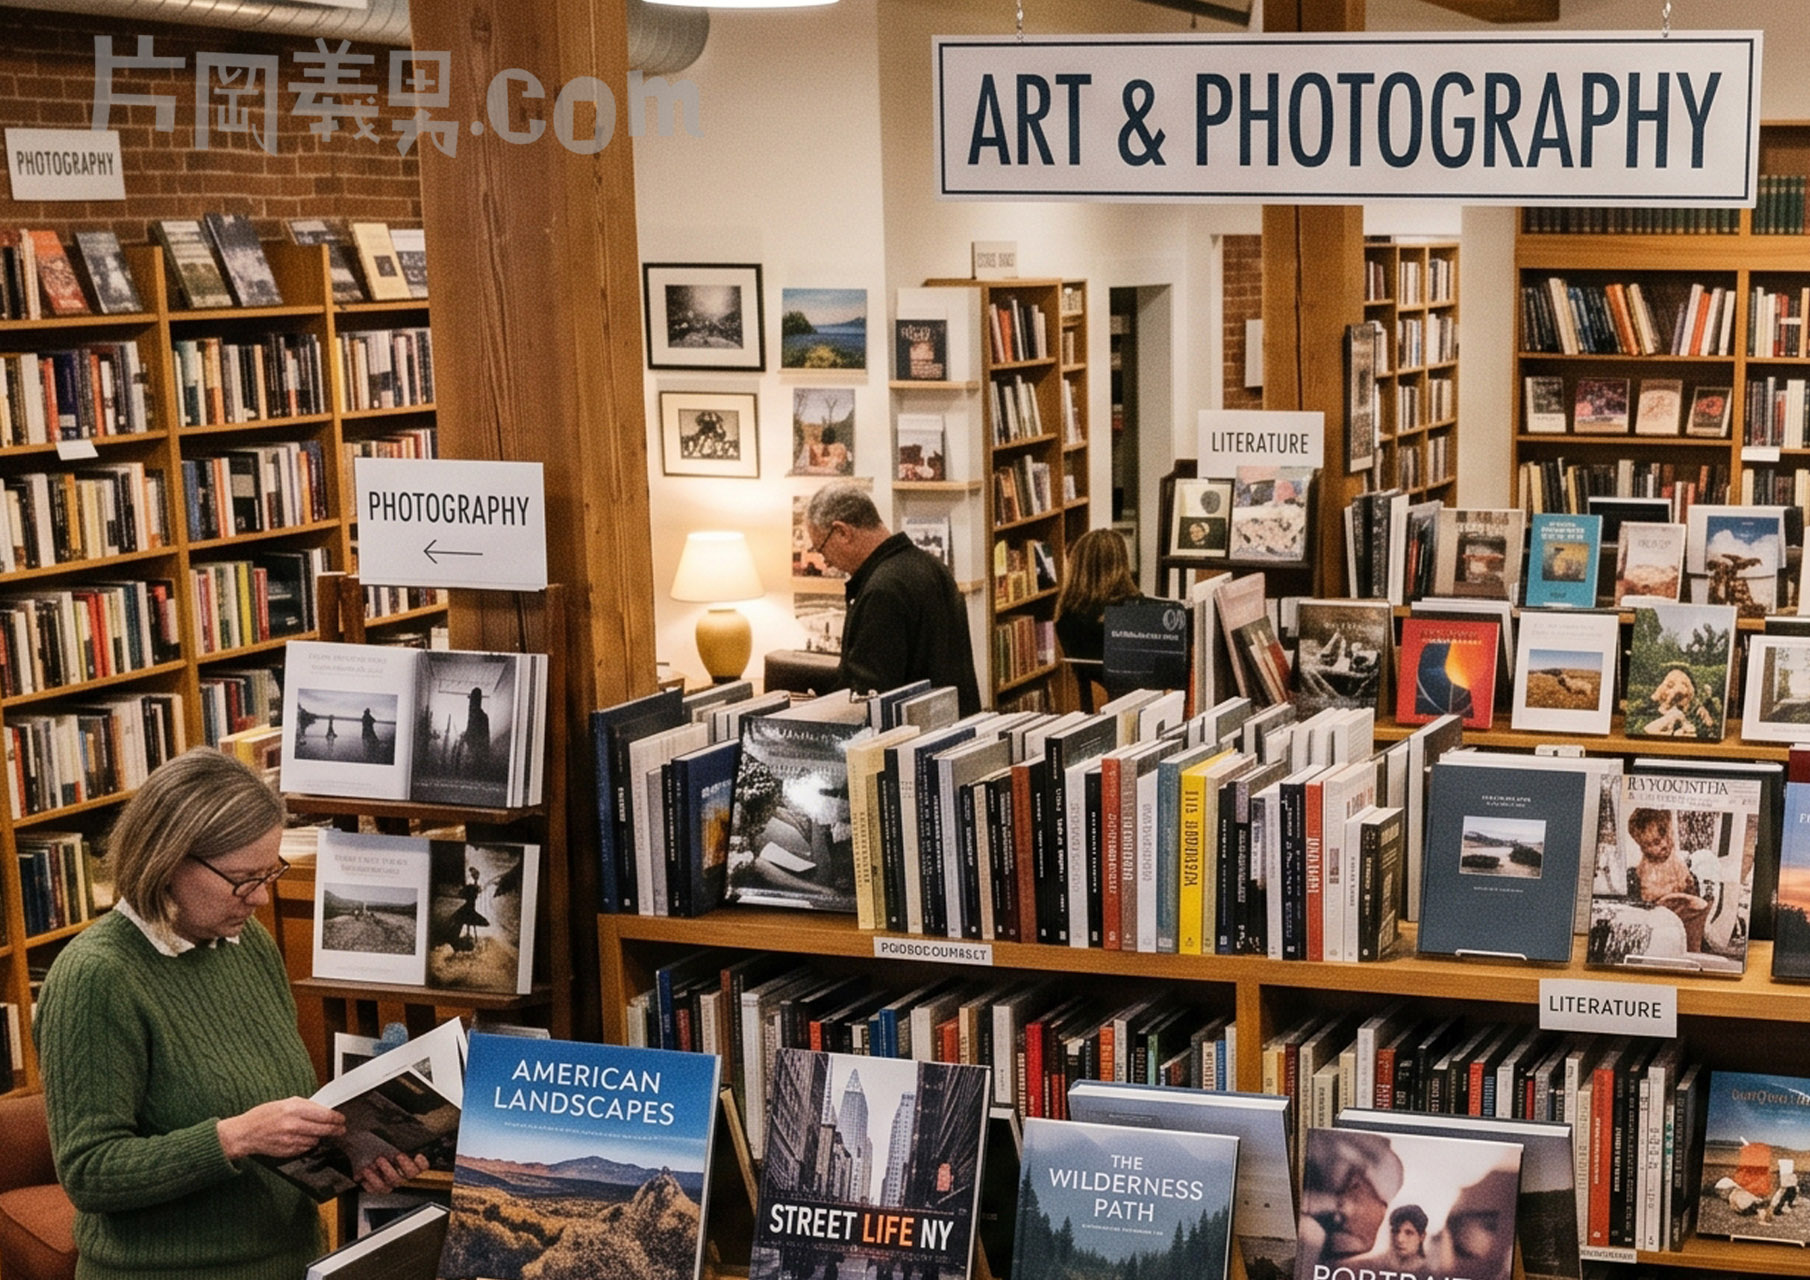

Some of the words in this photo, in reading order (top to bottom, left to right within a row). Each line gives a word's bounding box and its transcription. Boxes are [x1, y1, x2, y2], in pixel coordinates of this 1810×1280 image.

[967, 73, 1092, 166] ART
[1117, 79, 1167, 167] &
[1195, 71, 1723, 169] PHOTOGRAPHY
[16, 151, 114, 176] PHOTOGRAPHY
[1212, 431, 1309, 454] LITERATURE
[368, 491, 530, 527] PHOTOGRAPHY
[1549, 995, 1662, 1019] LITERATURE
[511, 1059, 661, 1095] AMERICAN
[493, 1085, 675, 1126] LANDSCAPES
[1110, 1154, 1144, 1171] THE
[1048, 1167, 1205, 1201] WILDERNESS
[768, 1202, 858, 1241] STREET
[861, 1212, 915, 1248] LIFE
[919, 1217, 955, 1252] NY
[1093, 1198, 1155, 1223] PATH
